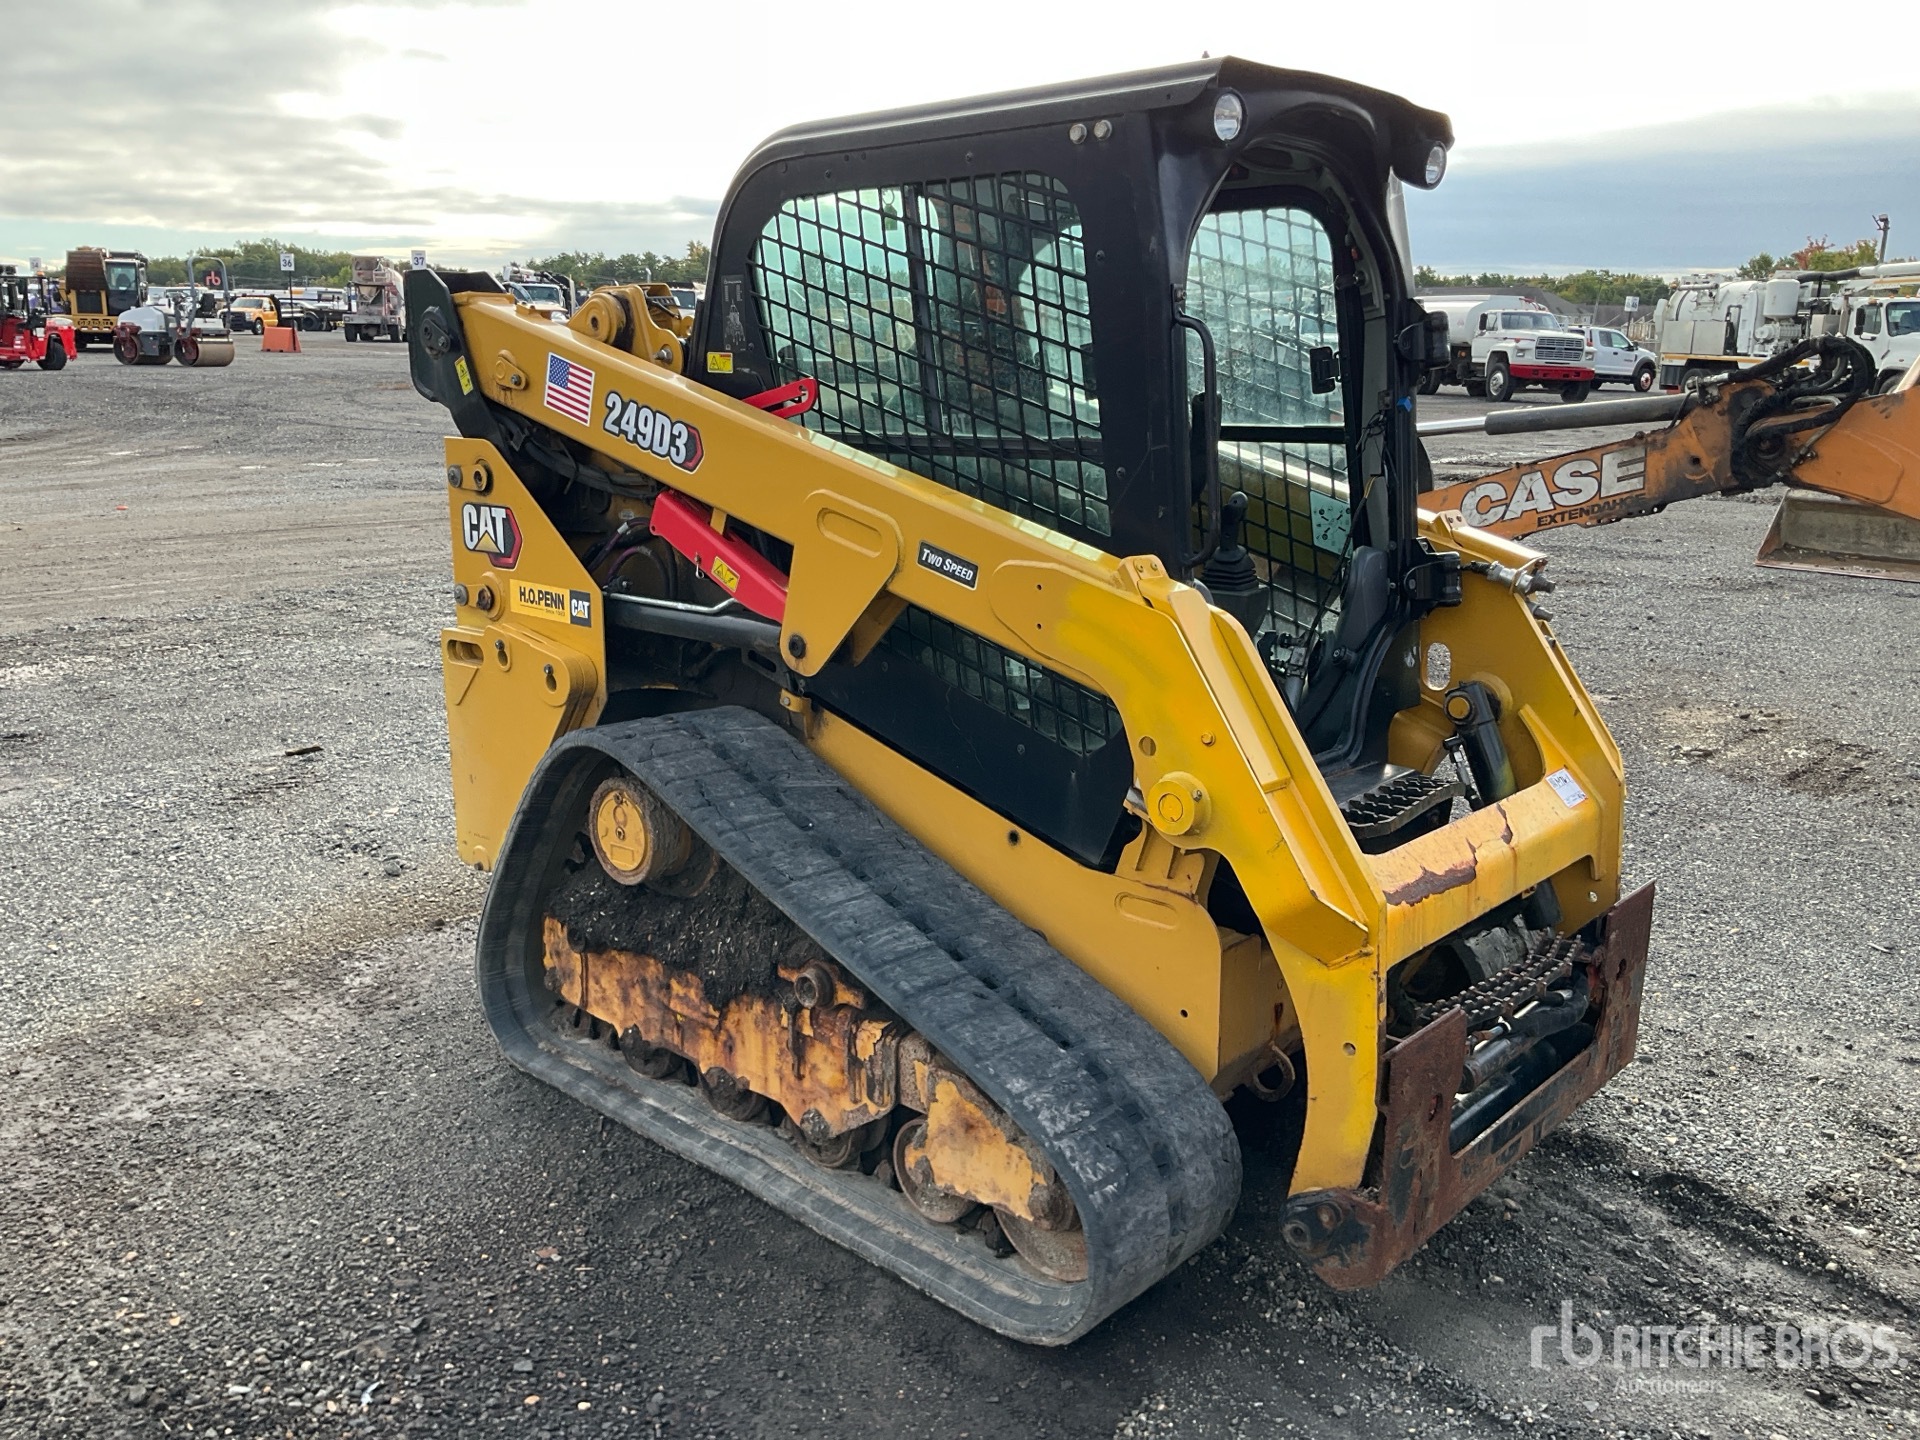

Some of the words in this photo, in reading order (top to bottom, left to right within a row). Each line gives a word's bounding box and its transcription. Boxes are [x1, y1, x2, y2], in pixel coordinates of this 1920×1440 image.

[205, 270, 221, 286] rb
[282, 259, 292, 268] 36
[413, 256, 425, 266] 37
[604, 391, 689, 465] 249D3
[1460, 448, 1647, 528] CASE
[462, 503, 507, 554] CAT
[519, 585, 565, 610] H.O.PENN
[571, 598, 590, 619] CAT
